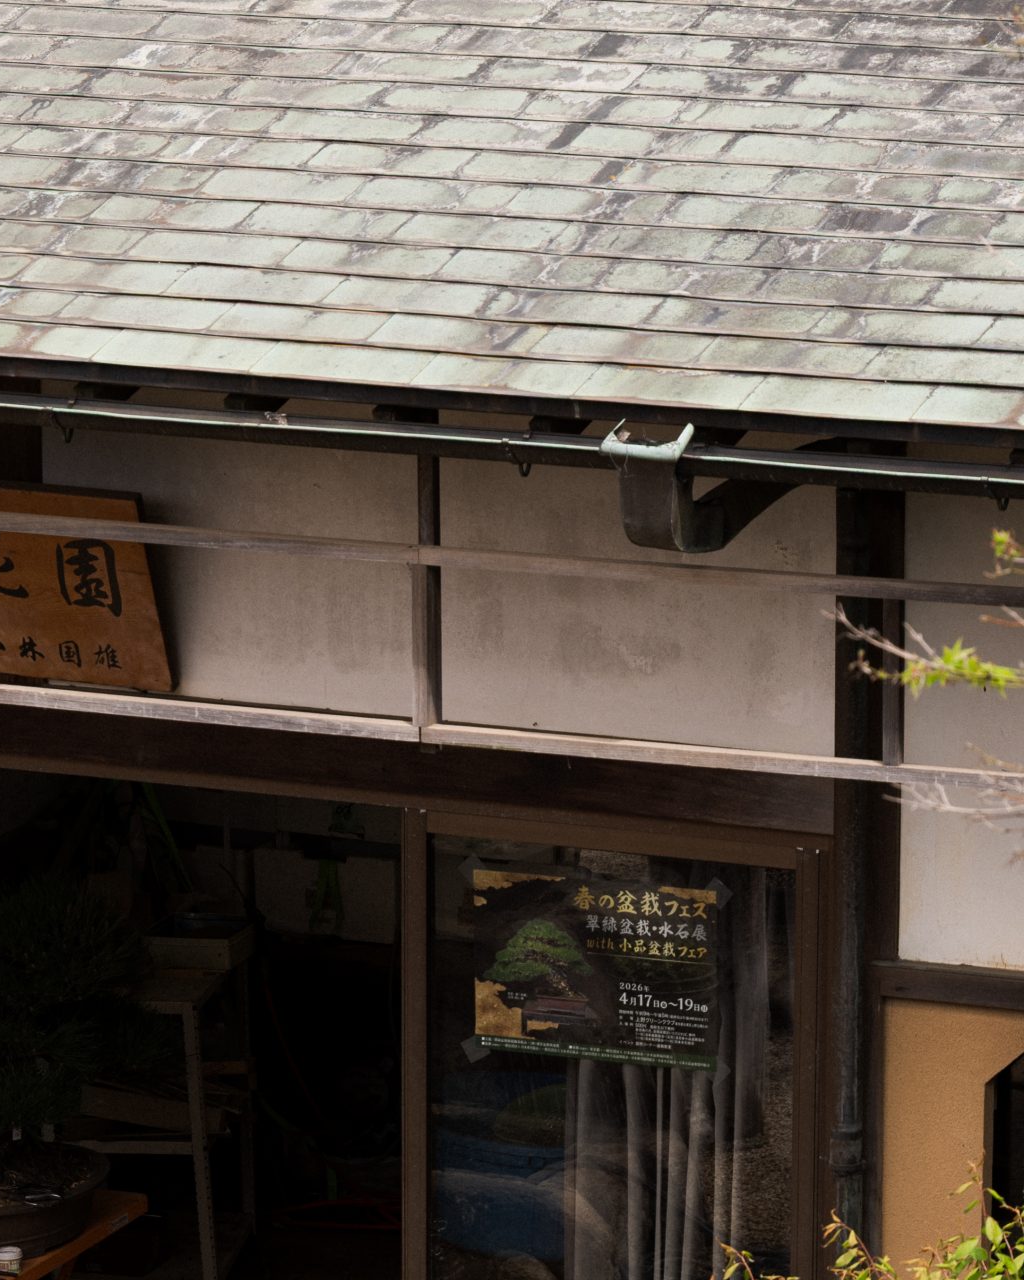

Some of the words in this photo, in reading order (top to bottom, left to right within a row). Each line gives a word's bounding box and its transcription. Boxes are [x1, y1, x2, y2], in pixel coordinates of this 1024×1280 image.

[573, 885, 707, 919] 春の盆栽フェス
[585, 914, 707, 941] 翠緑盆栽・水石展
[586, 937, 615, 950] with
[618, 938, 708, 958] 小品盆栽フェア
[619, 982, 649, 992] 2026年
